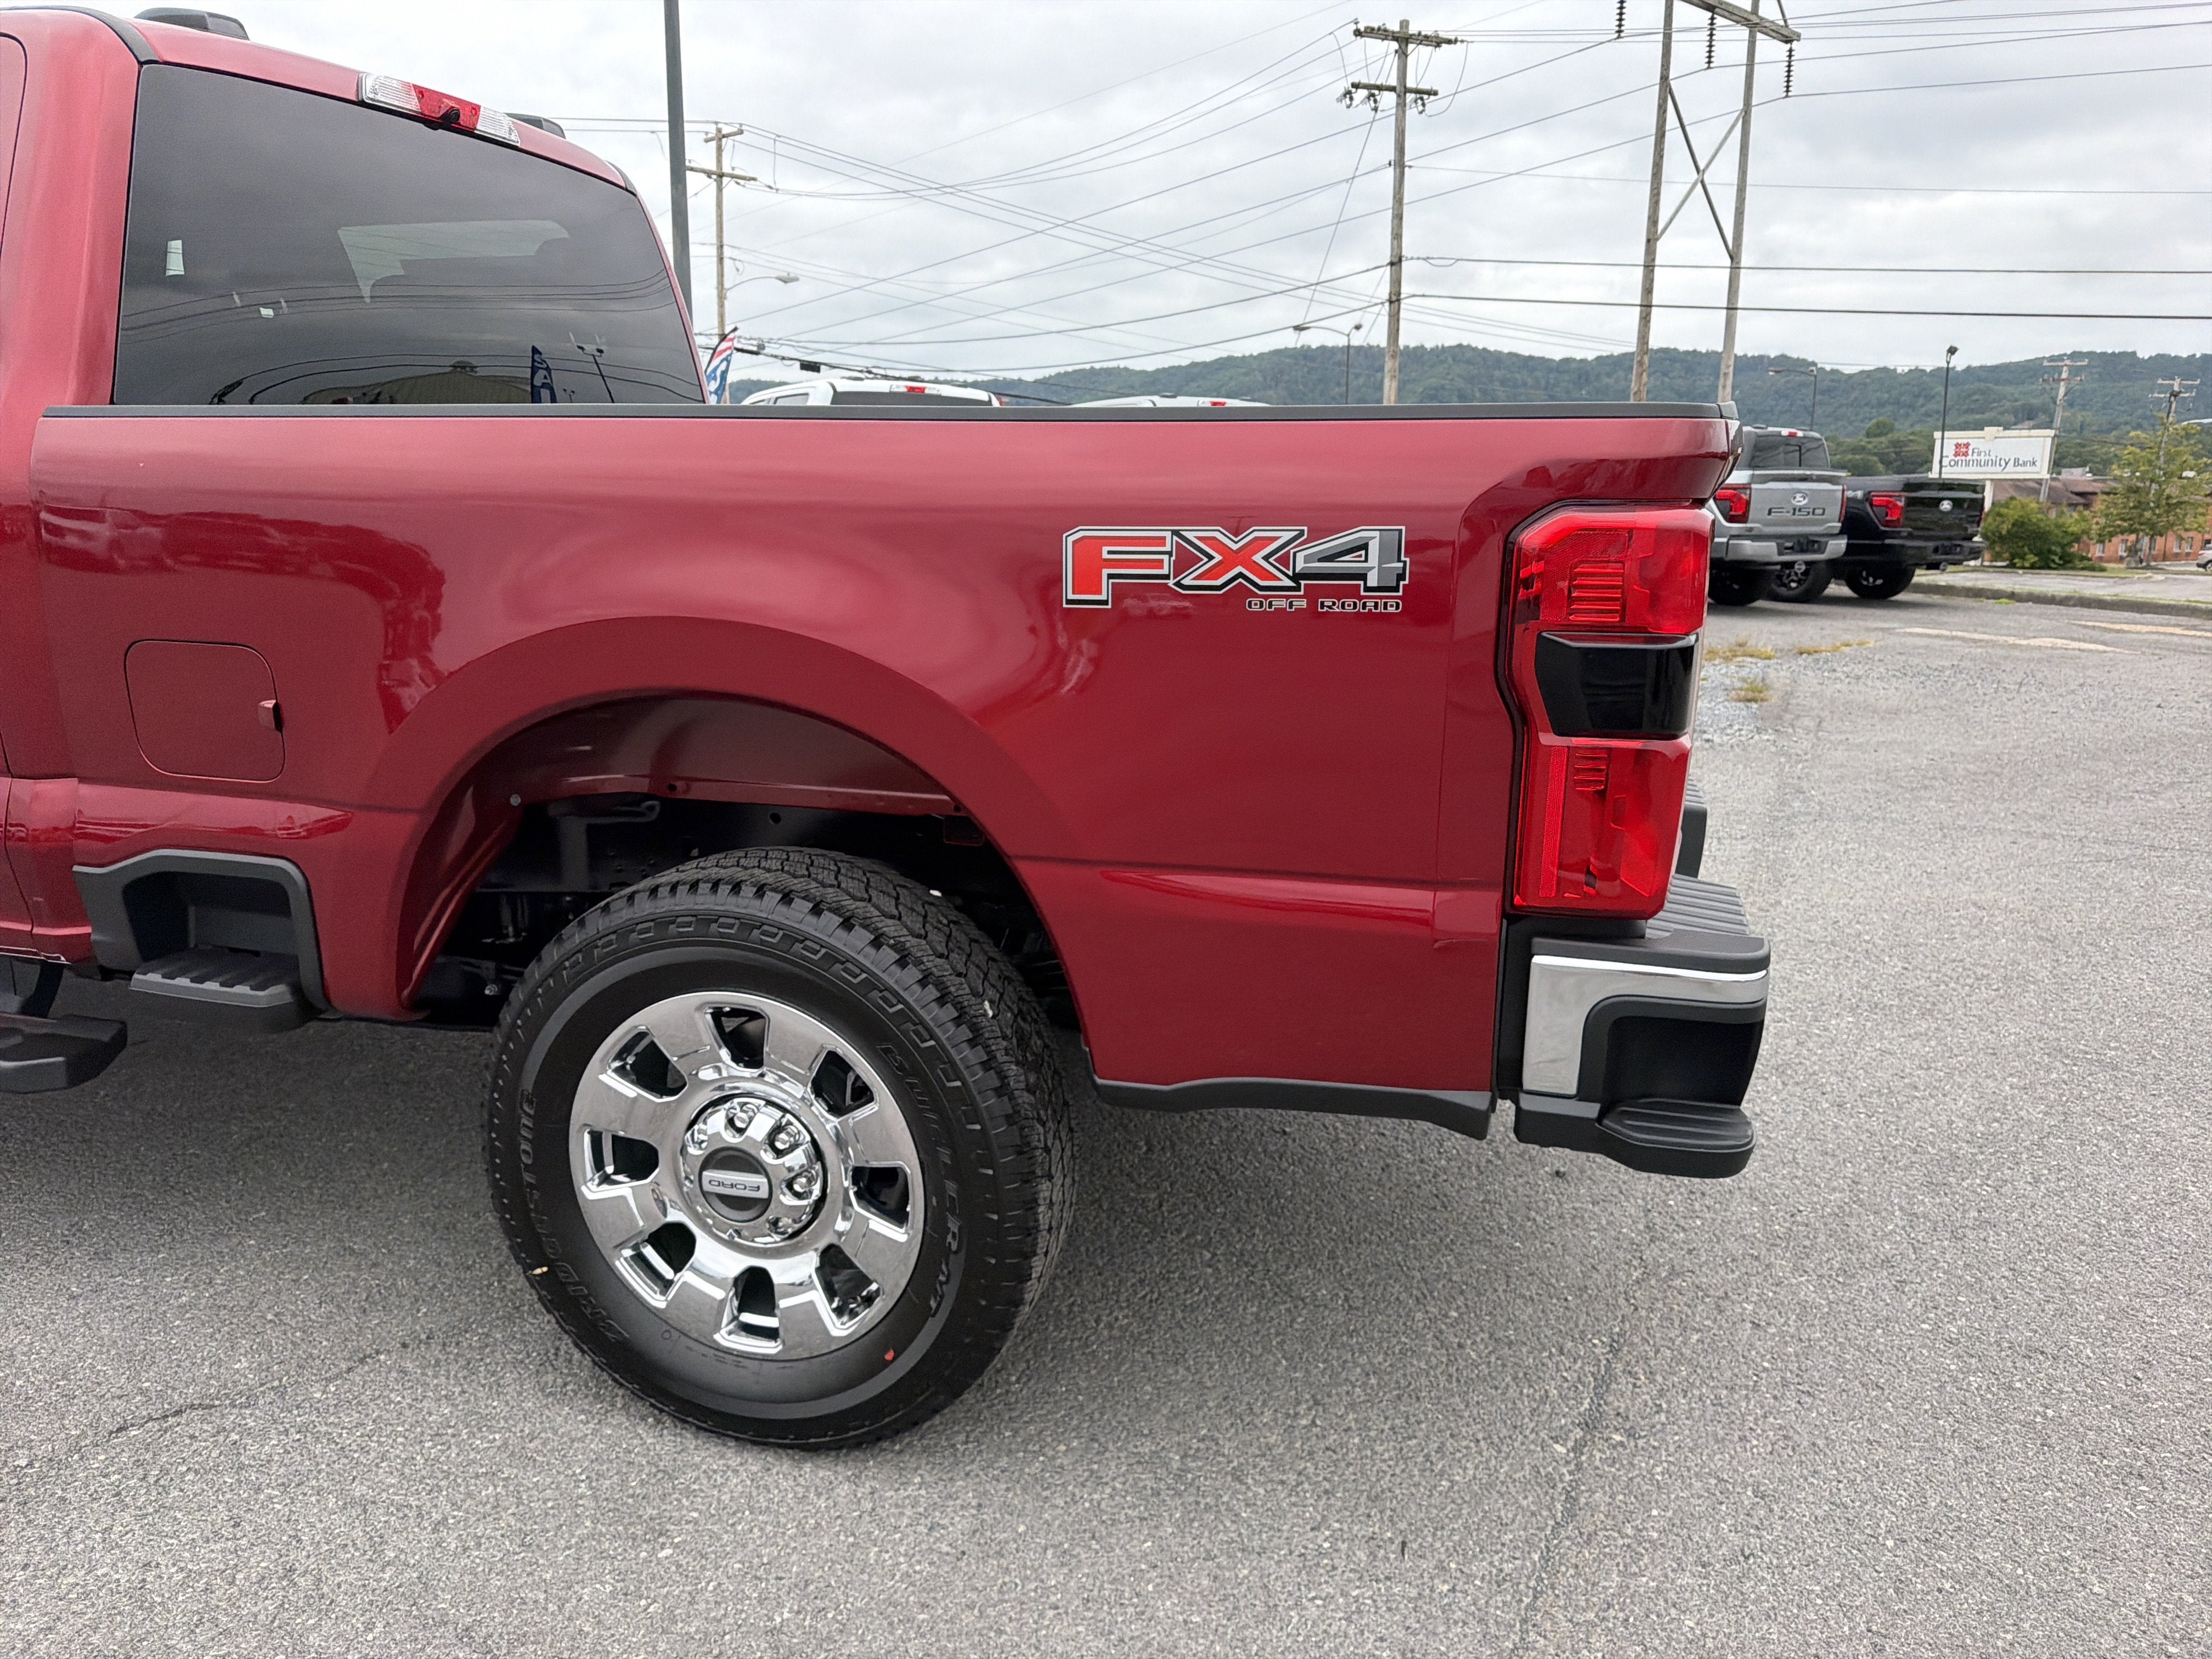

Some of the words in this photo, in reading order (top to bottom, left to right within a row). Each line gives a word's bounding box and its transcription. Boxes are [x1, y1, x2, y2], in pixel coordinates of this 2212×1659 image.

[1971, 447, 1991, 457] First
[1940, 455, 2011, 472] Community
[2013, 457, 2038, 467] Bank
[1767, 507, 1826, 516] F-150
[1063, 526, 1409, 608] FX4
[1246, 598, 1307, 611] OFF
[1318, 599, 1402, 612] ROAD
[708, 1179, 760, 1192] FORD
